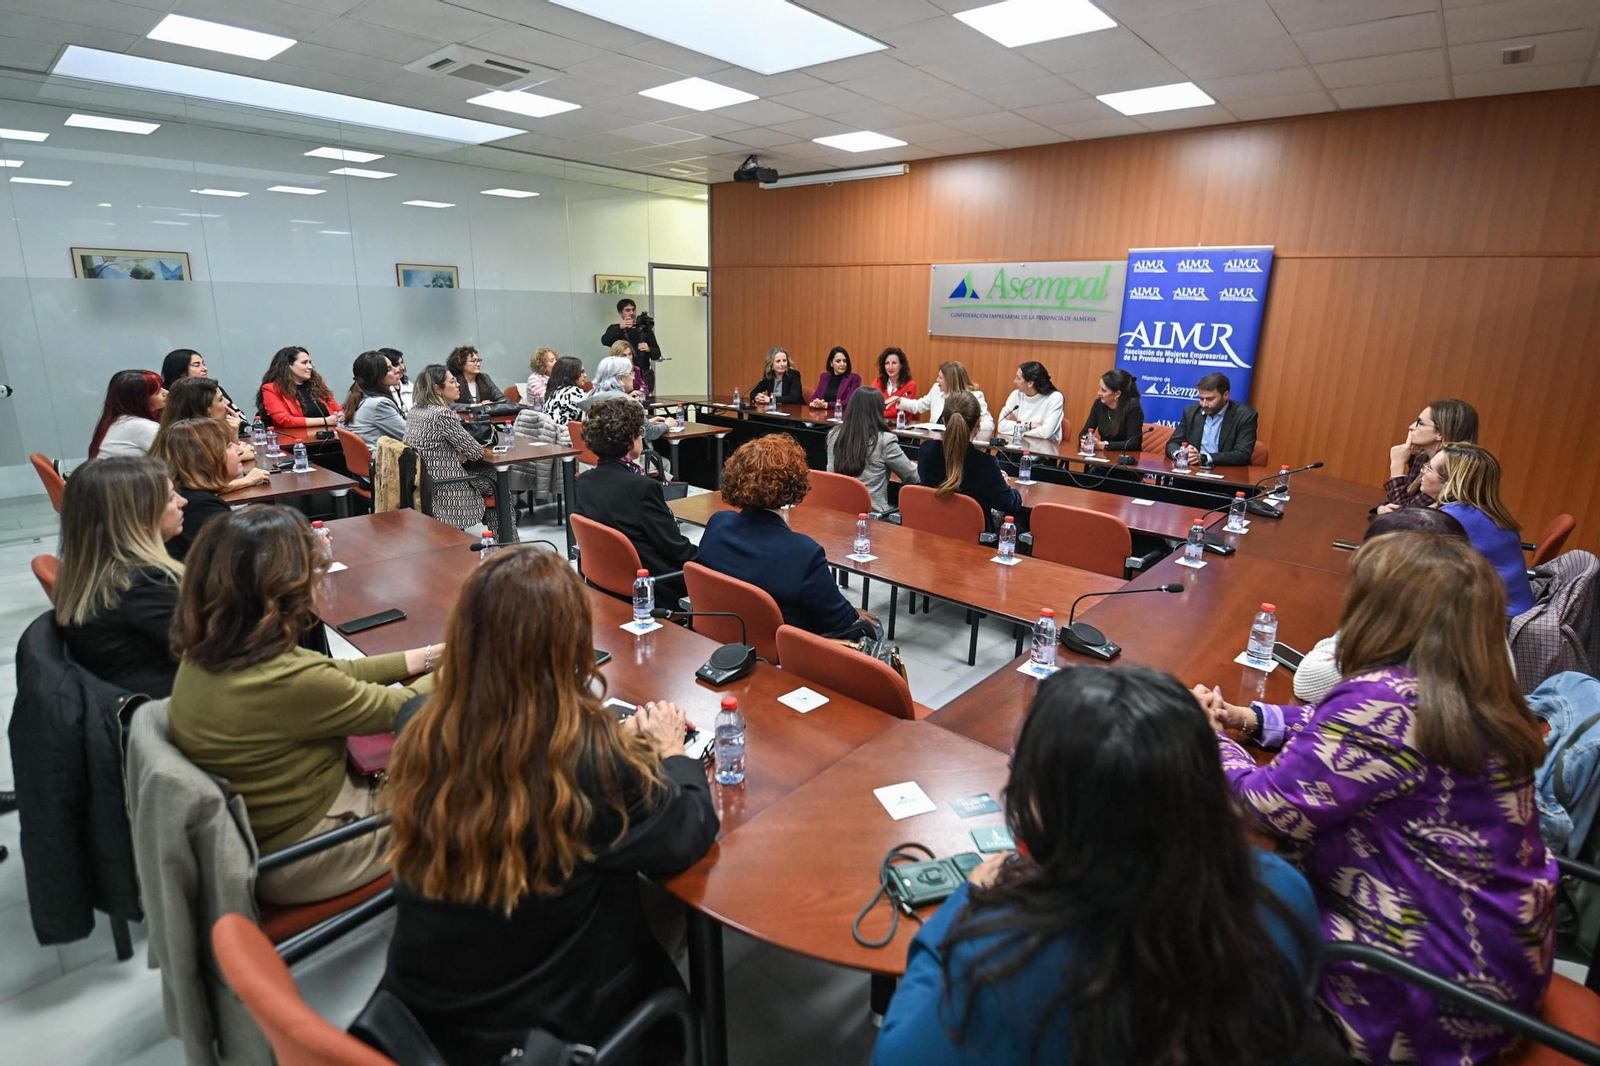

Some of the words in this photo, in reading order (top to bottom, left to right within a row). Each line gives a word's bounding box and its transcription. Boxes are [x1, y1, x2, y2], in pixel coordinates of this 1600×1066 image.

[1133, 260, 1168, 273] ALMUR
[1176, 259, 1214, 273] ALMUR
[1223, 258, 1263, 273] ALMUR
[985, 265, 1112, 307] Asempal
[1129, 287, 1164, 300] ALMUR
[1172, 287, 1209, 301] ALMUR
[1219, 288, 1258, 302] ALMUR
[1119, 321, 1251, 368] ALMUR
[1124, 348, 1155, 356] Asociación
[1165, 350, 1189, 358] Mujeres
[1190, 351, 1228, 361] Empresarias
[1139, 355, 1165, 363] Provincia
[1161, 382, 1200, 399] Asemp
